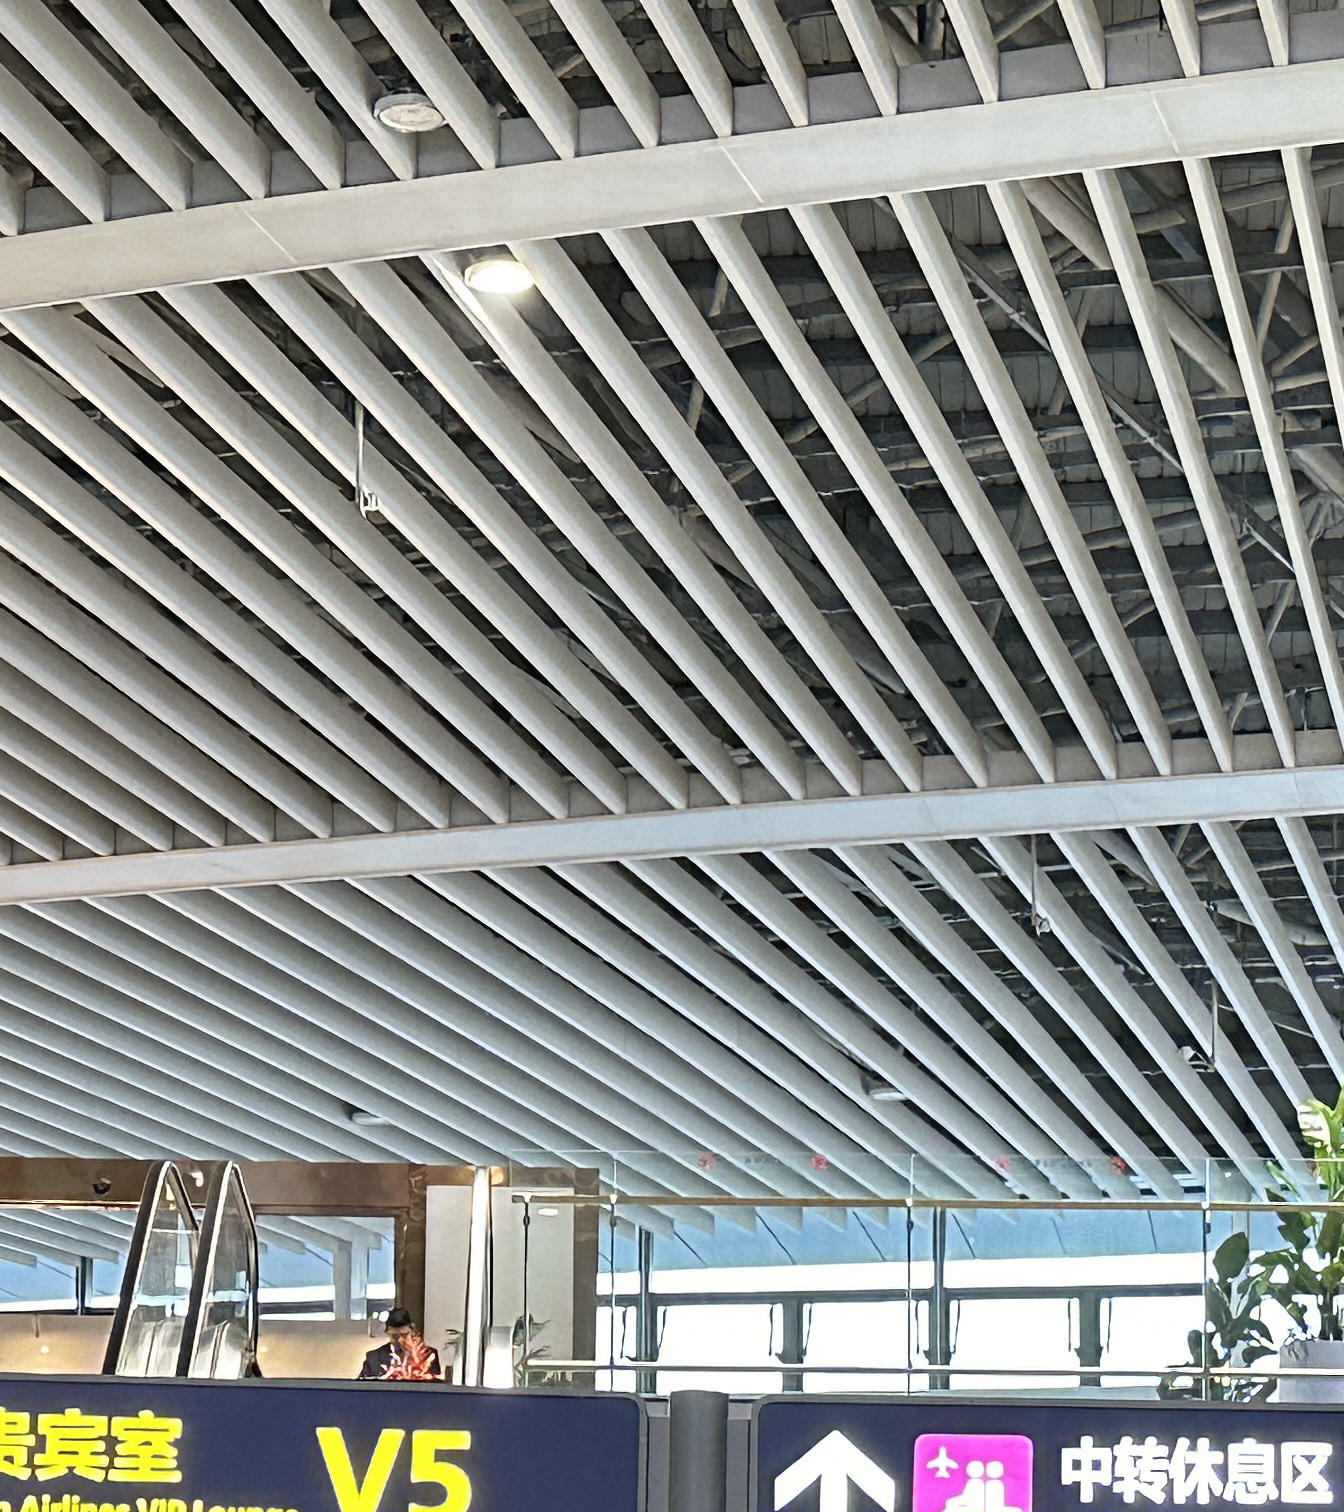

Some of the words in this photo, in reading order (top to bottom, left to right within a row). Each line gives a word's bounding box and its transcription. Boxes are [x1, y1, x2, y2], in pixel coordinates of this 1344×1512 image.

[1061, 1435, 1333, 1505] 中转休息区
